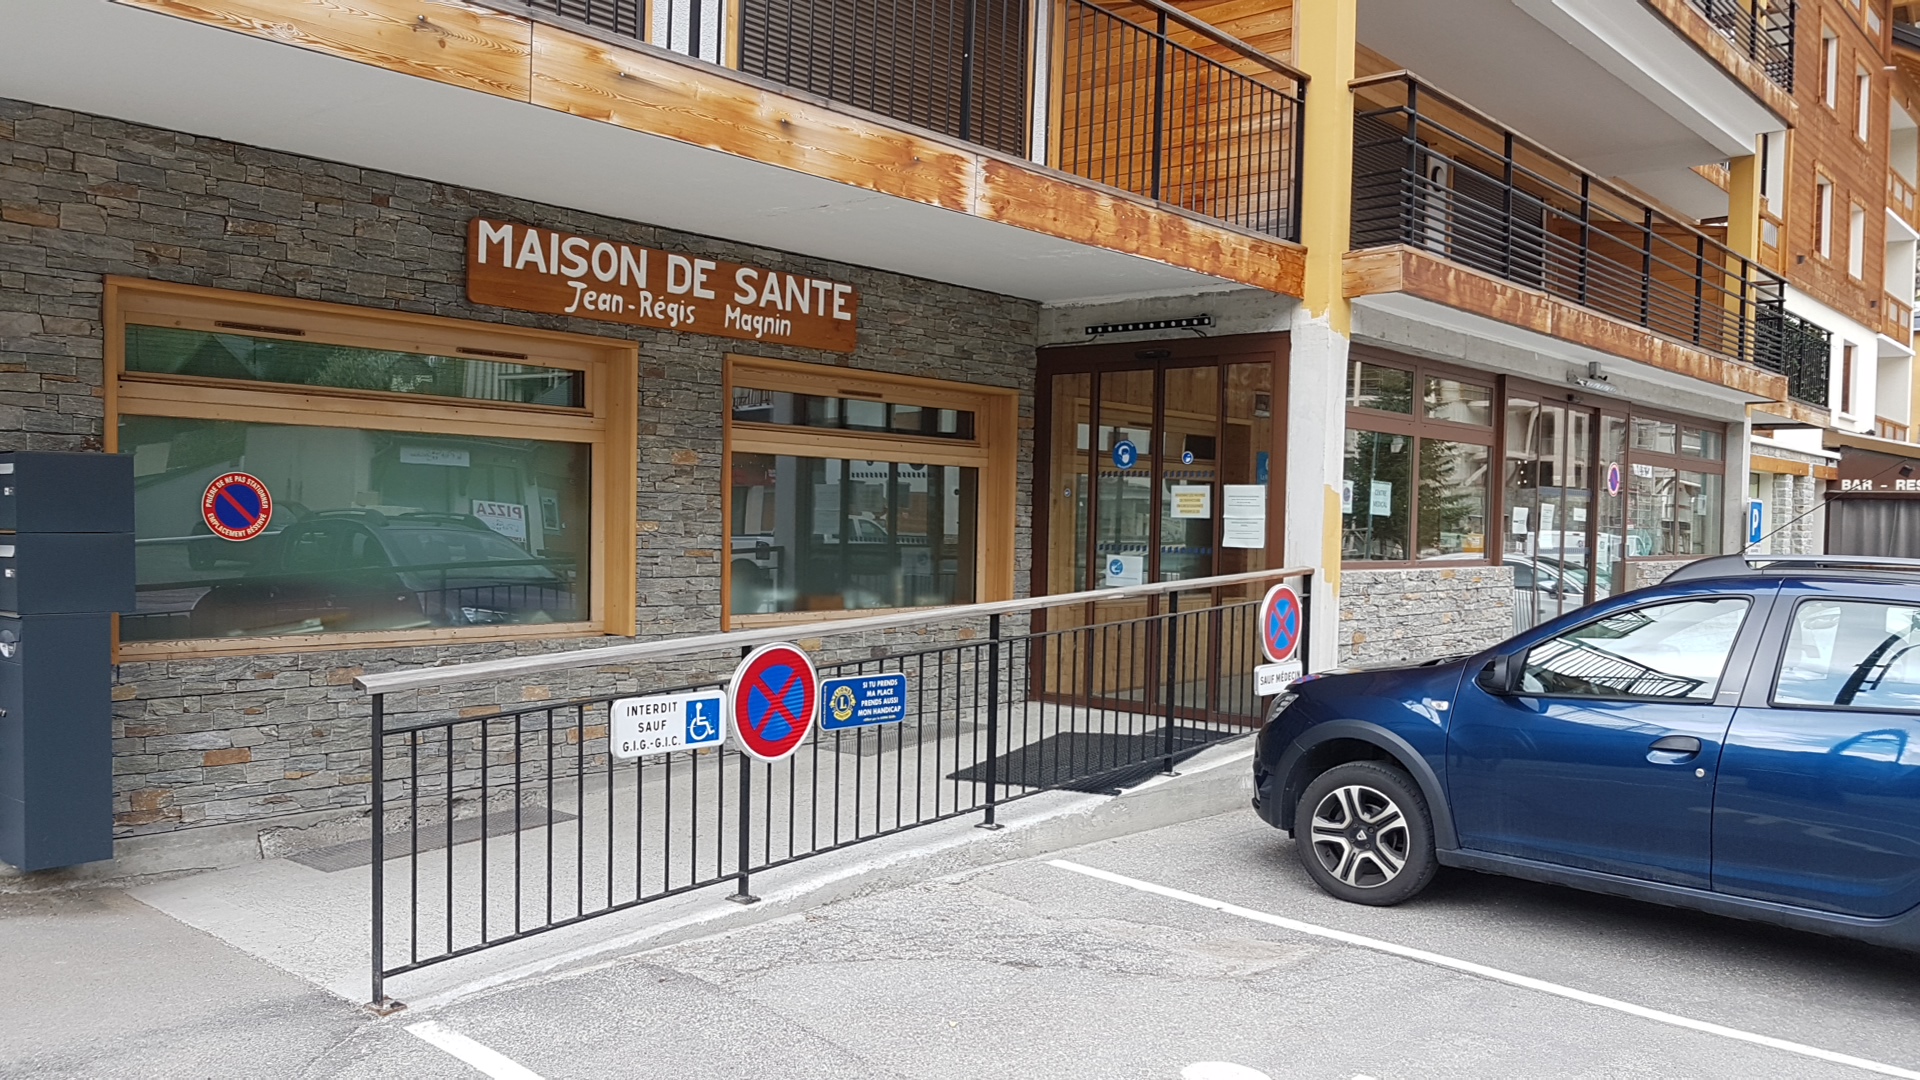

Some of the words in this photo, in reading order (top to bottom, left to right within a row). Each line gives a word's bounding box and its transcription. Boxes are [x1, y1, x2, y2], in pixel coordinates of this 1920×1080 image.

[478, 220, 647, 288] MAISON
[667, 254, 716, 299] DE
[734, 267, 851, 321] SANTE
[724, 304, 791, 339] Magnin
[1841, 479, 1873, 491] BAR
[206, 486, 218, 508] PRIÈRE
[216, 480, 225, 488] DE
[246, 478, 268, 508] STATIONNER
[207, 512, 246, 538] EMPLACEMENT
[1751, 508, 1759, 536] P
[1260, 674, 1275, 685] SAUF
[1275, 670, 1300, 683] MÉDECIN
[627, 702, 678, 717] INTERDIT
[840, 696, 847, 709] L
[861, 698, 882, 706] PRENDS
[873, 706, 901, 714] HANDICAP
[638, 720, 667, 733] SAUF
[623, 736, 681, 752] G.I.G.-G.I.C.
